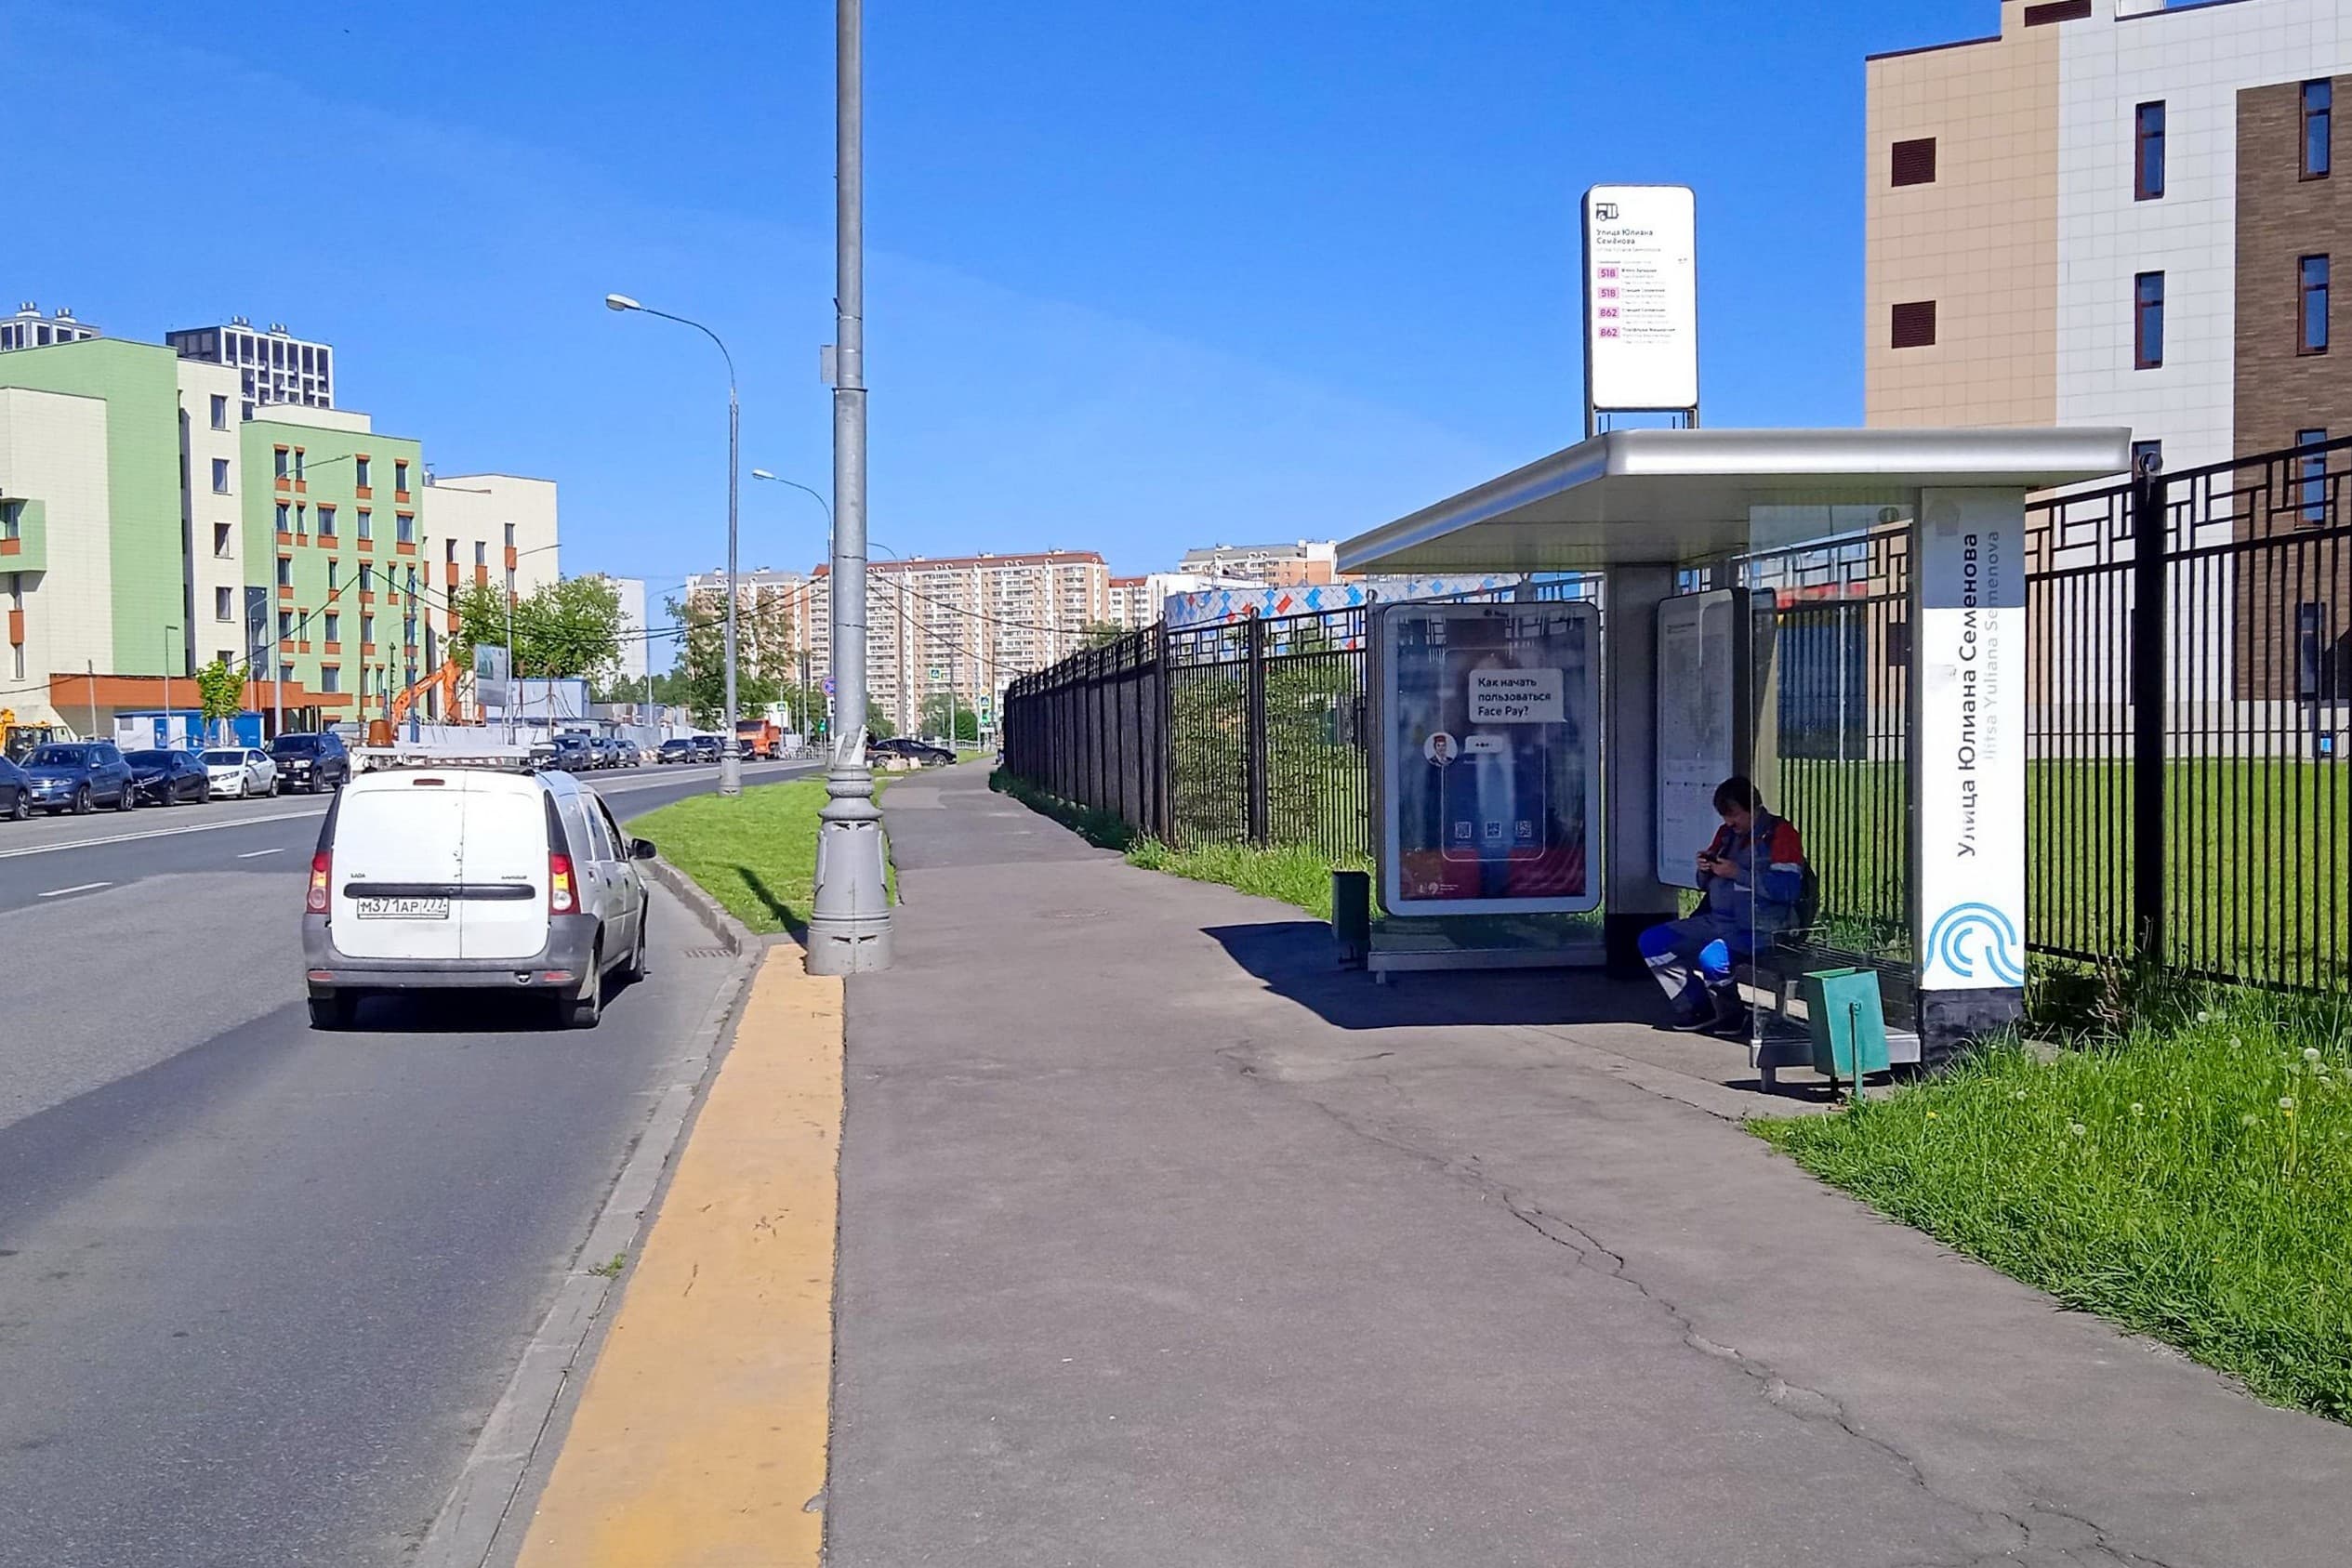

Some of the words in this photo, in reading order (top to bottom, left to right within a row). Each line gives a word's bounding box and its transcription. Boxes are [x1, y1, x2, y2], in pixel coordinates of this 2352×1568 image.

[1601, 269, 1616, 278] 518
[1601, 289, 1616, 297] 518
[1600, 309, 1618, 317] 862
[1601, 328, 1618, 336] 862
[1985, 532, 2000, 631] Semenova
[1959, 534, 1977, 661] Семенова
[1984, 637, 1998, 709] Yuliana
[1478, 678, 1499, 687] Как
[1500, 679, 1537, 687] начать
[1478, 692, 1552, 701] пользоваться
[1478, 706, 1502, 716] Face
[1505, 705, 1529, 718] Pay?
[1958, 669, 1976, 771] Юлиана
[1958, 780, 1977, 857] Улица
